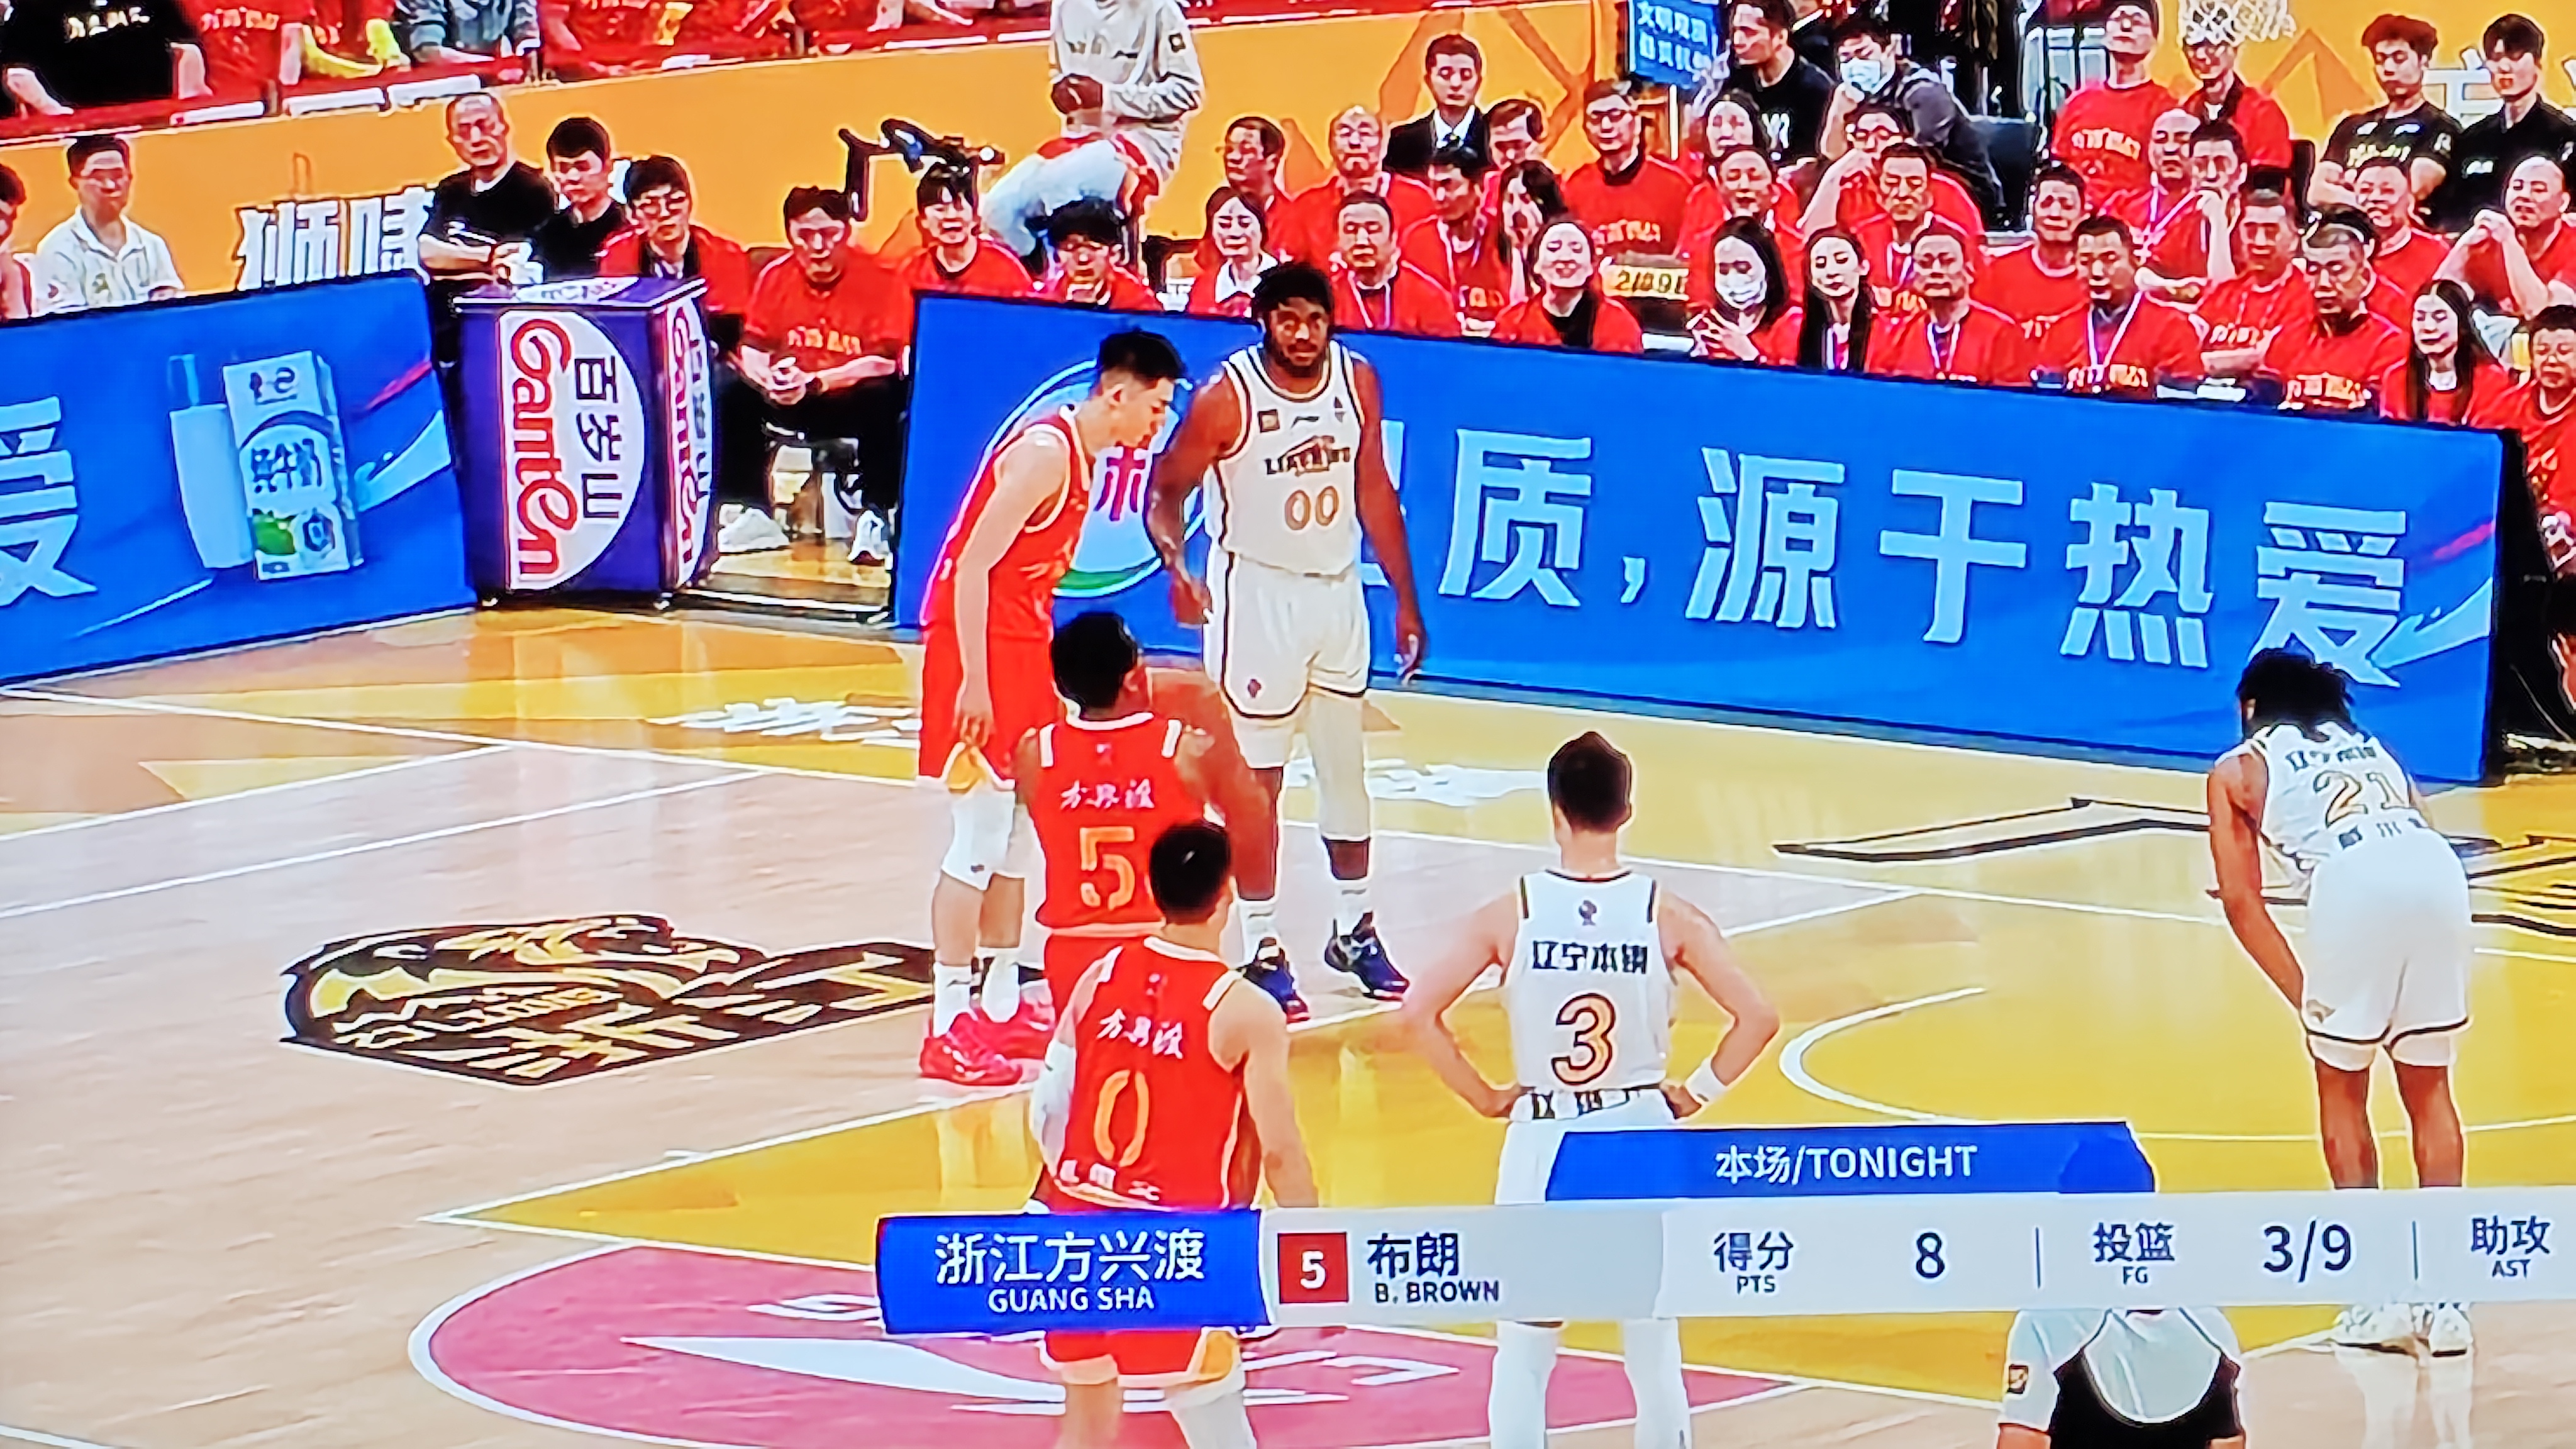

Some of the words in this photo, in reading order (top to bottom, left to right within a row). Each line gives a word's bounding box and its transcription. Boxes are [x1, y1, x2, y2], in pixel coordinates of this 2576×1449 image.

[575, 355, 622, 518] 百岁山
[1284, 485, 1340, 531] 00
[2313, 769, 2410, 830] 21
[1080, 825, 1136, 912] 5
[1532, 940, 1648, 975] 辽宁本钢
[1551, 992, 1616, 1086] 3
[1094, 1069, 1151, 1168] 0
[1716, 1145, 1978, 1185] 本场/TONIGHT
[1367, 1231, 1459, 1276] 布朗
[1713, 1231, 1794, 1274] 得分
[1915, 1231, 1946, 1279] 8
[2093, 1221, 2175, 1263] 投篮
[2263, 1218, 2352, 1283] 3/9
[2470, 1215, 2551, 1256] 助攻
[936, 1230, 1204, 1285] 浙江方兴渡
[1298, 1252, 1327, 1289] 5
[2123, 1266, 2148, 1285] FG
[2491, 1259, 2529, 1279] AST
[987, 1287, 1088, 1313] GUANG
[1097, 1286, 1155, 1310] SHA
[1375, 1281, 1399, 1305] B.
[1406, 1280, 1499, 1303] BROWN
[1736, 1275, 1775, 1294] PTS
